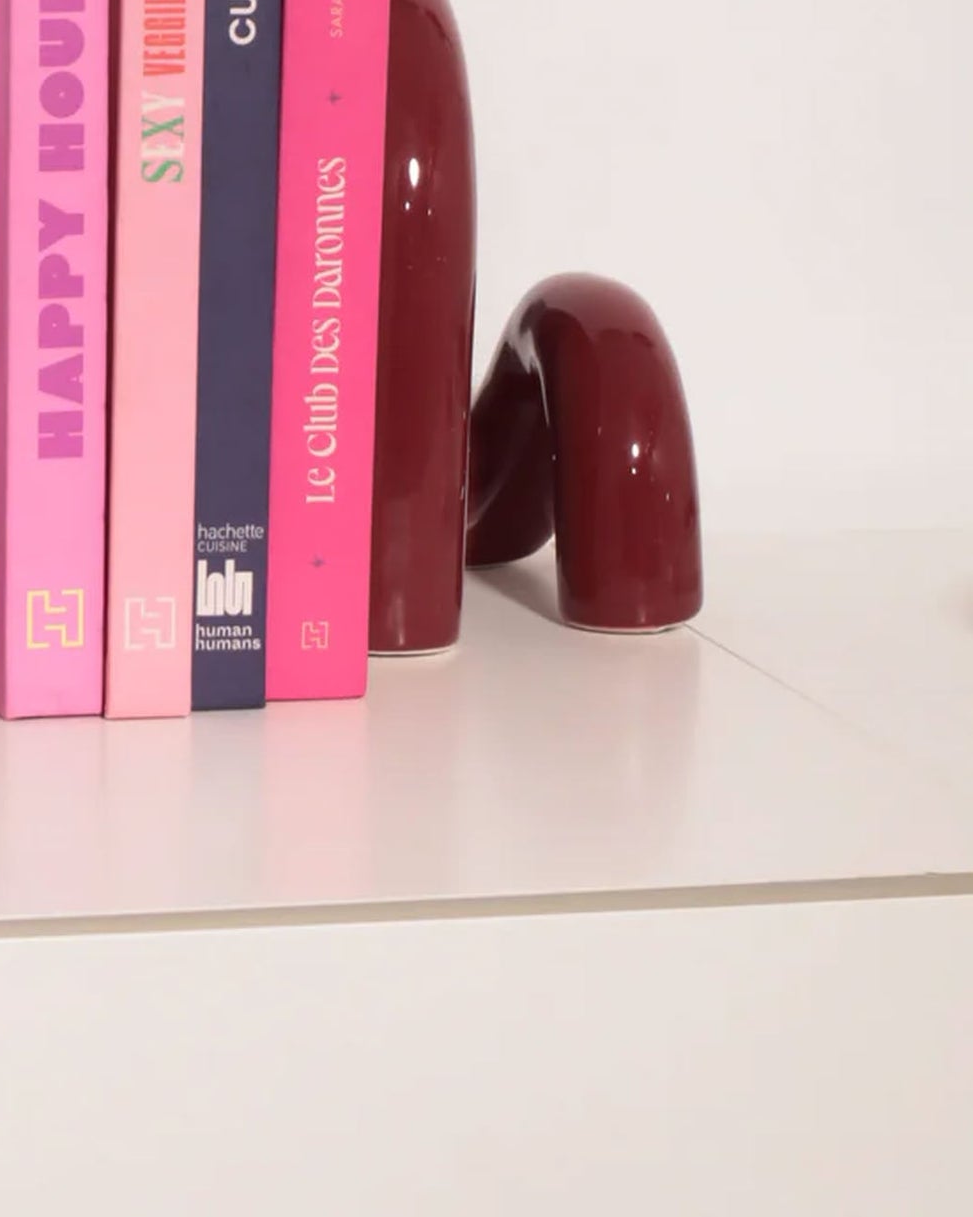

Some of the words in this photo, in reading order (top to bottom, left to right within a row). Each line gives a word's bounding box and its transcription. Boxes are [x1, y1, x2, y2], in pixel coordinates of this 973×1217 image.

[141, 90, 185, 183] SEXY
[37, 200, 84, 458] HAPPY
[197, 523, 264, 539] hachette
[197, 541, 247, 553] CUISINE
[195, 624, 252, 637] human
[195, 637, 261, 650] humans
